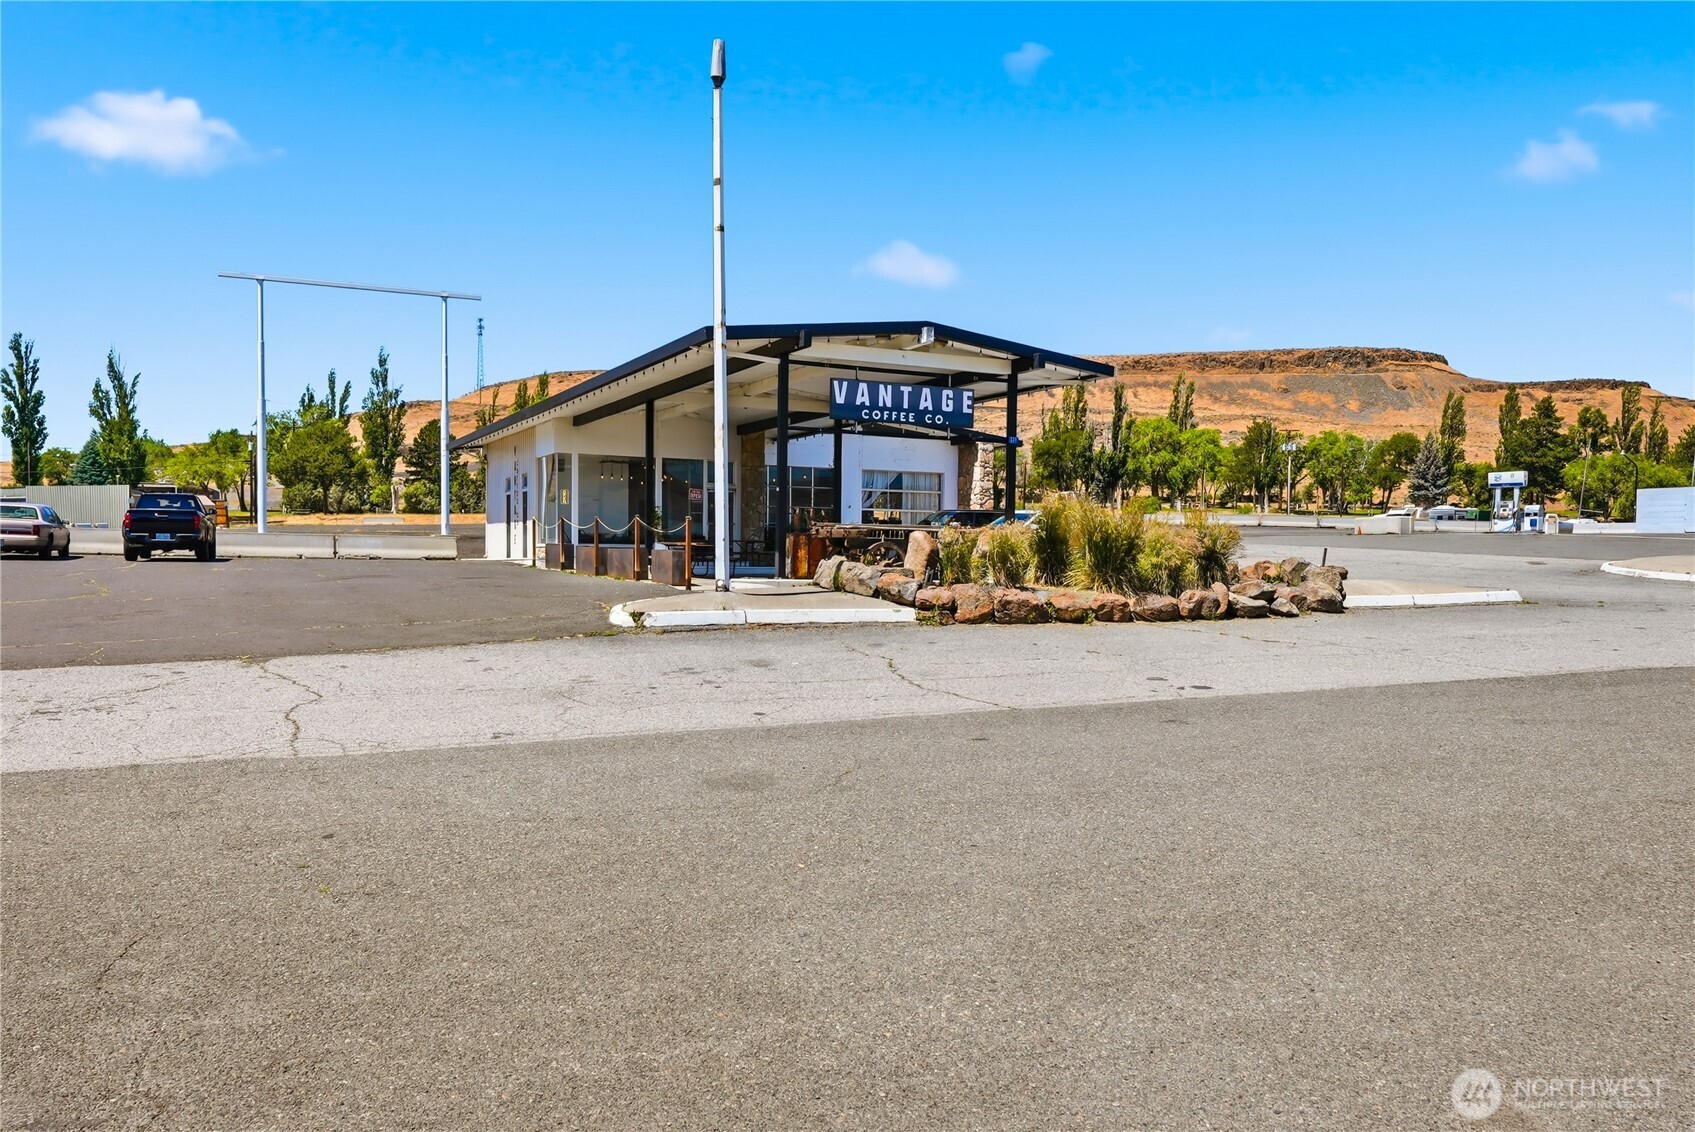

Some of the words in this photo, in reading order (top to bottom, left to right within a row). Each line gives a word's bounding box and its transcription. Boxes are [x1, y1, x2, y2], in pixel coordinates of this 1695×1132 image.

[833, 380, 972, 414] VANTAGE
[861, 409, 915, 422] COFFEE
[925, 414, 949, 425] CO.
